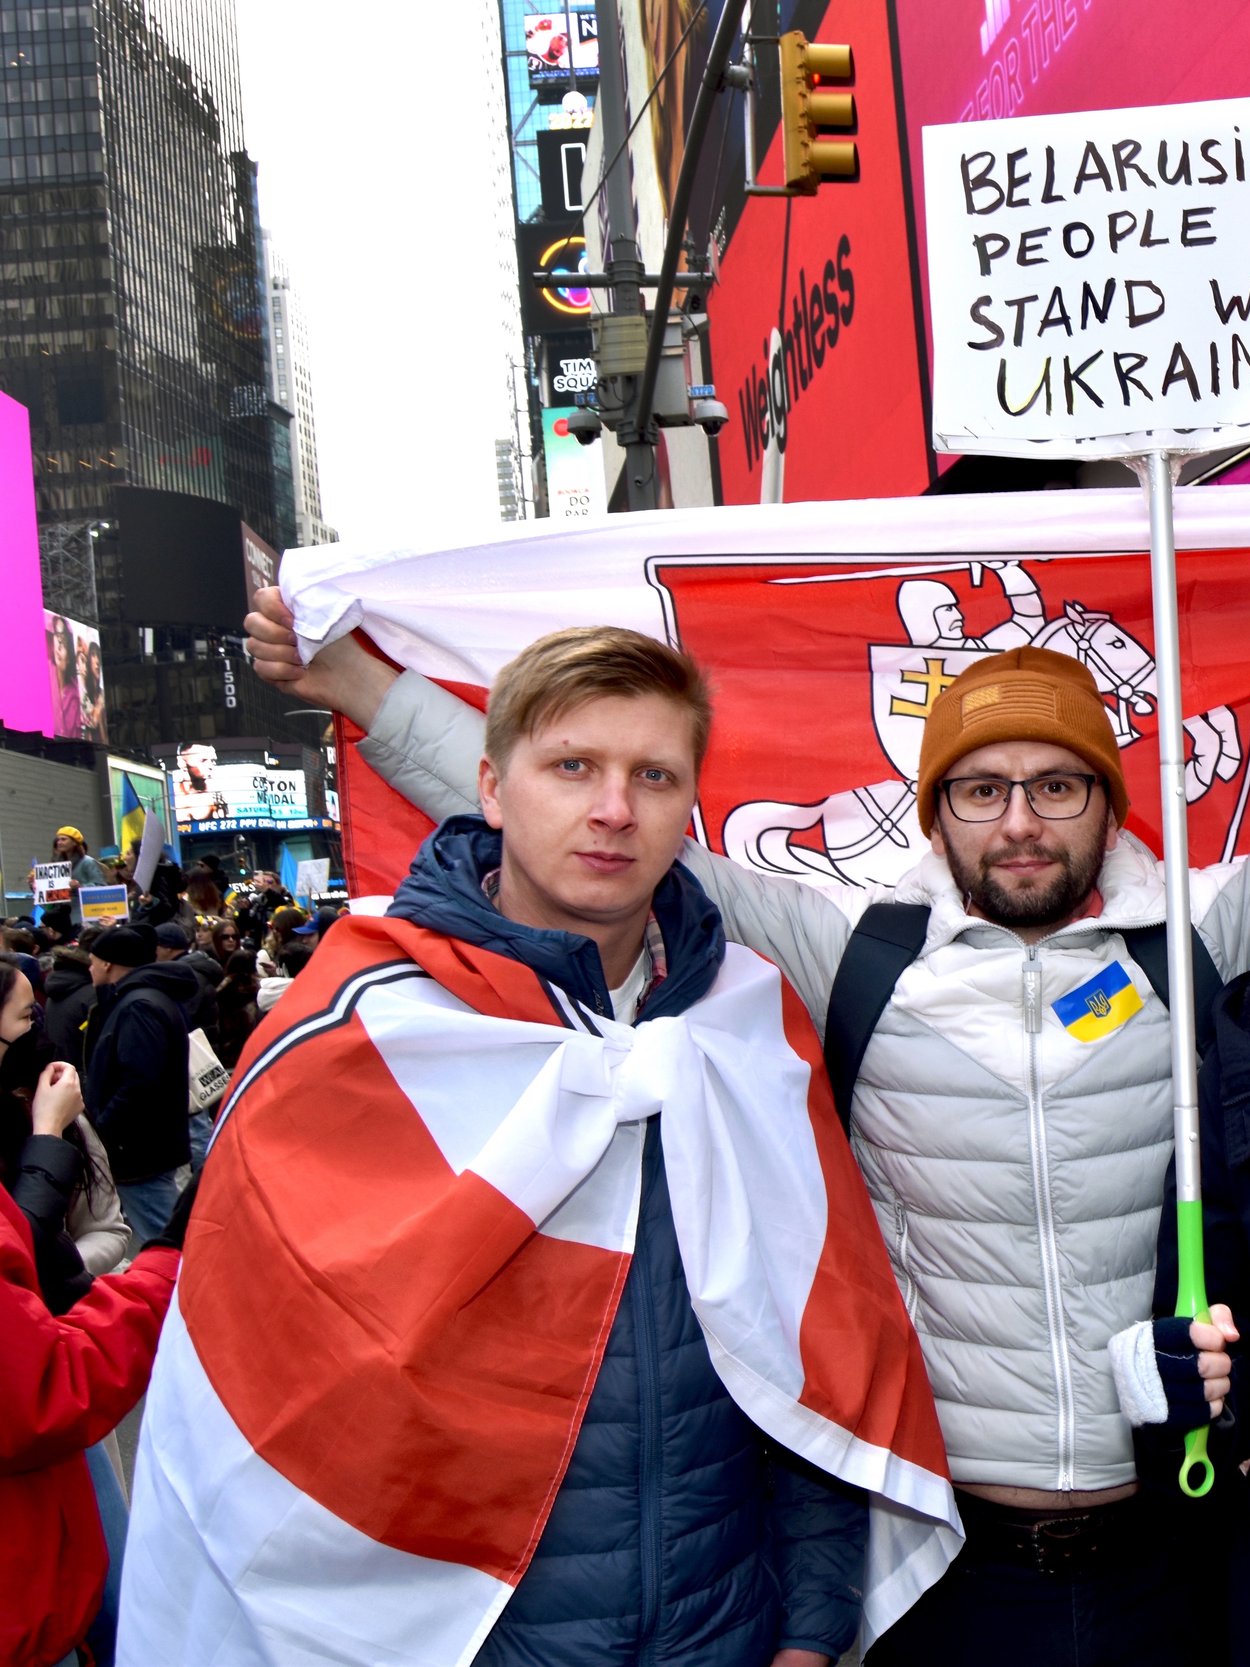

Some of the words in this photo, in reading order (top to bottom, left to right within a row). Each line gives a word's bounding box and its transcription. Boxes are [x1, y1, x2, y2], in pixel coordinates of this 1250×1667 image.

[972, 206, 1217, 277] PEOPLE
[967, 277, 1166, 351] STAND
[739, 233, 855, 473] Weightless
[224, 659, 237, 709] 1500
[199, 820, 217, 831] UFC
[220, 820, 237, 830] 272
[36, 864, 71, 880] INACTION
